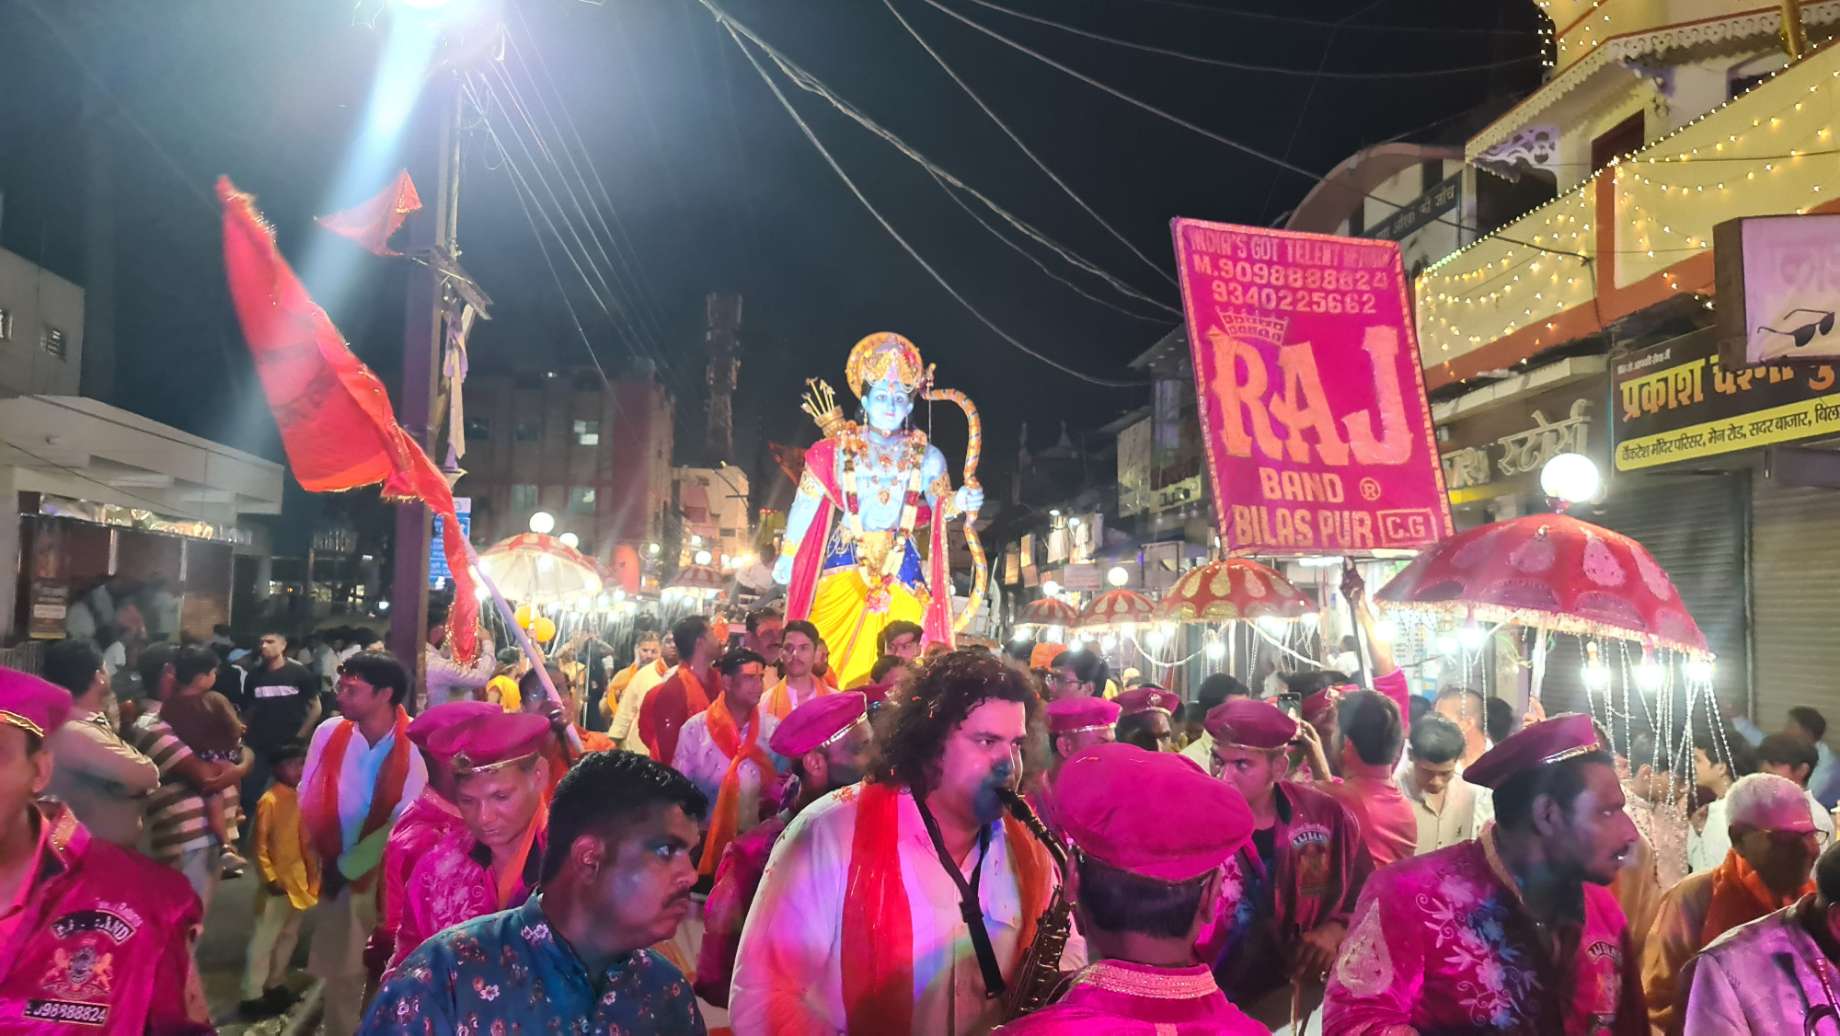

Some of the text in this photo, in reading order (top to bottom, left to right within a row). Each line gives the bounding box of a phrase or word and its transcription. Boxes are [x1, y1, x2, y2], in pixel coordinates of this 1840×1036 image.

[1251, 235, 1279, 261] GOT
[1211, 280, 1377, 314] 9340225662
[1206, 324, 1414, 466] RAJ
[1620, 358, 1705, 422] प्रकाश
[1708, 427, 1725, 445] मेन
[1749, 418, 1774, 437] सदर
[1775, 411, 1812, 431] बाजार,
[1815, 403, 1840, 425] बिल
[1259, 466, 1344, 503] BAND
[1231, 504, 1313, 548] BILAS
[1318, 508, 1374, 549] PUR
[25, 1002, 106, 1022] 98888824
